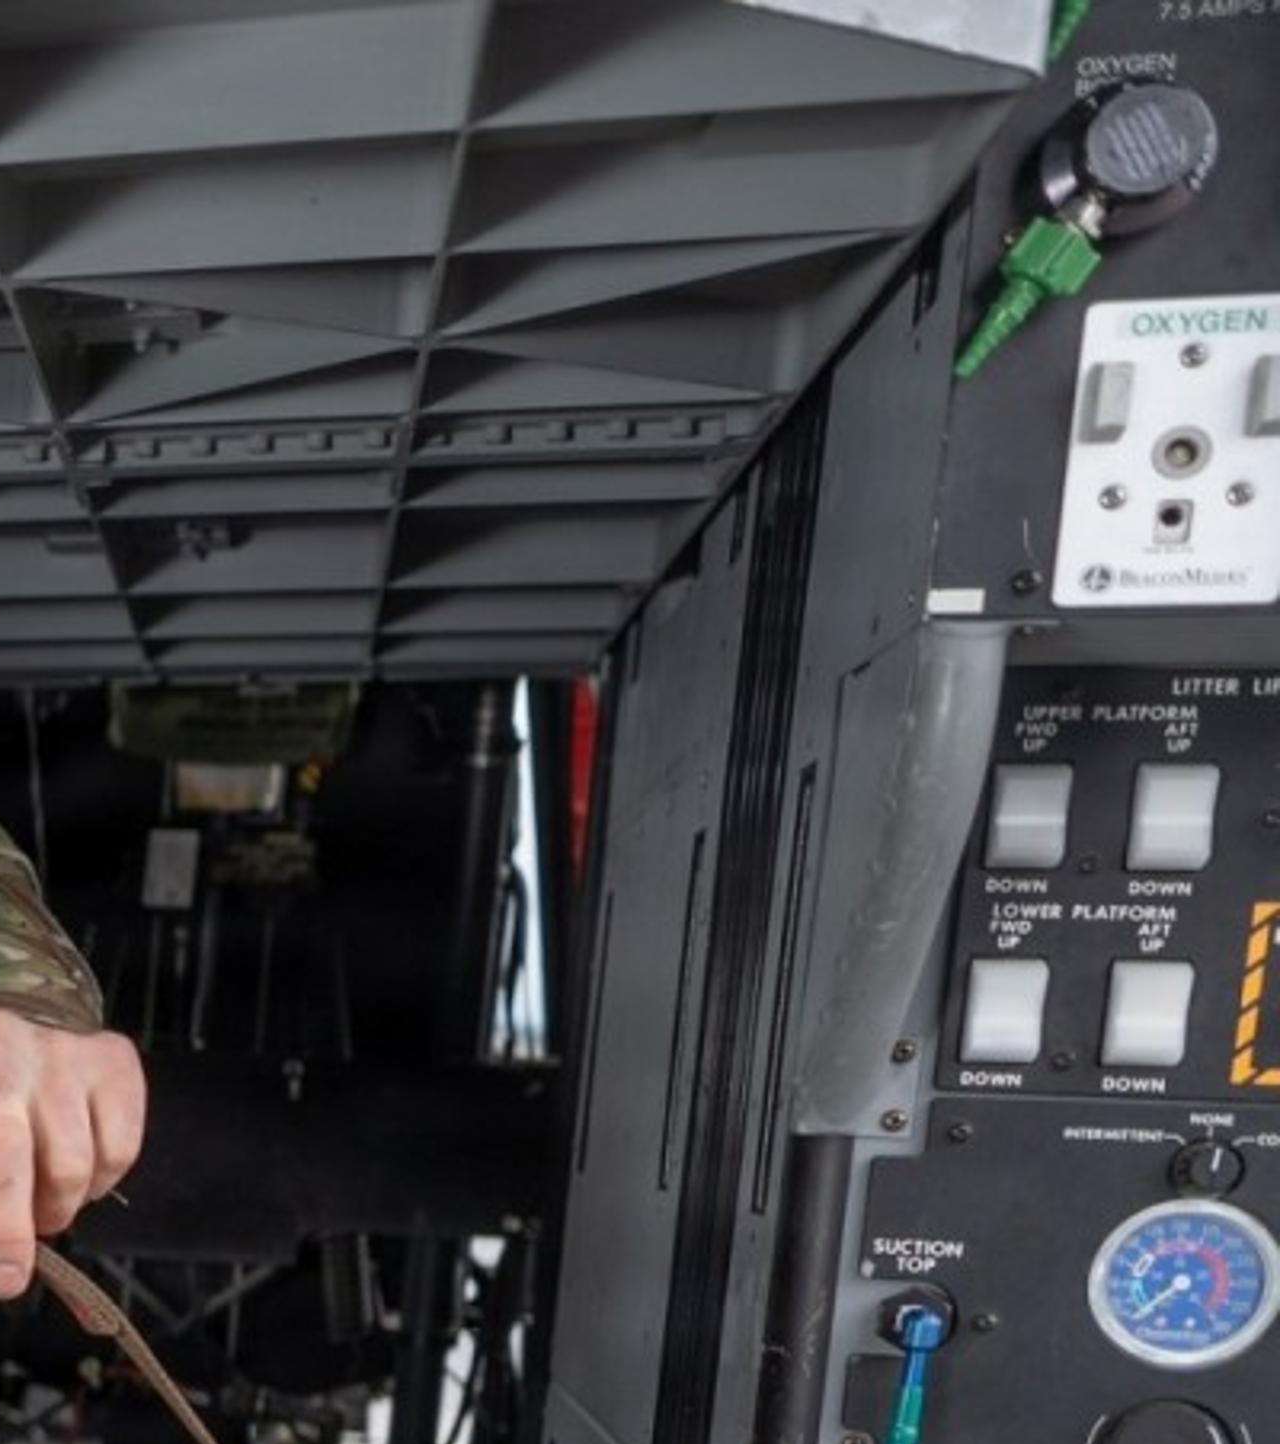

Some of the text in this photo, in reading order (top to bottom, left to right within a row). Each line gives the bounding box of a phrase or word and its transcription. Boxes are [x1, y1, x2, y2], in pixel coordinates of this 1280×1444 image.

[1077, 54, 1177, 76] OXYGEN
[1131, 306, 1268, 336] OXYGEN
[1171, 677, 1239, 695] LITTER
[1023, 704, 1198, 721] UPPER PLATFORM
[1015, 722, 1058, 737] FWD
[1164, 722, 1199, 737] AFT
[1023, 738, 1047, 752] UP
[1167, 738, 1191, 752] UP
[985, 879, 1047, 894] DOWN
[1128, 881, 1193, 896] DOWN
[992, 902, 1177, 922] LOWER PLATFORM
[990, 920, 1032, 935] FWD
[1138, 924, 1172, 937] AFT
[997, 936, 1021, 949] UP
[1140, 938, 1165, 952] UP
[959, 1071, 1023, 1087] DOWN
[1101, 1077, 1166, 1093] DOWN
[873, 1237, 964, 1259] SUCTION
[896, 1256, 936, 1274] TOP
